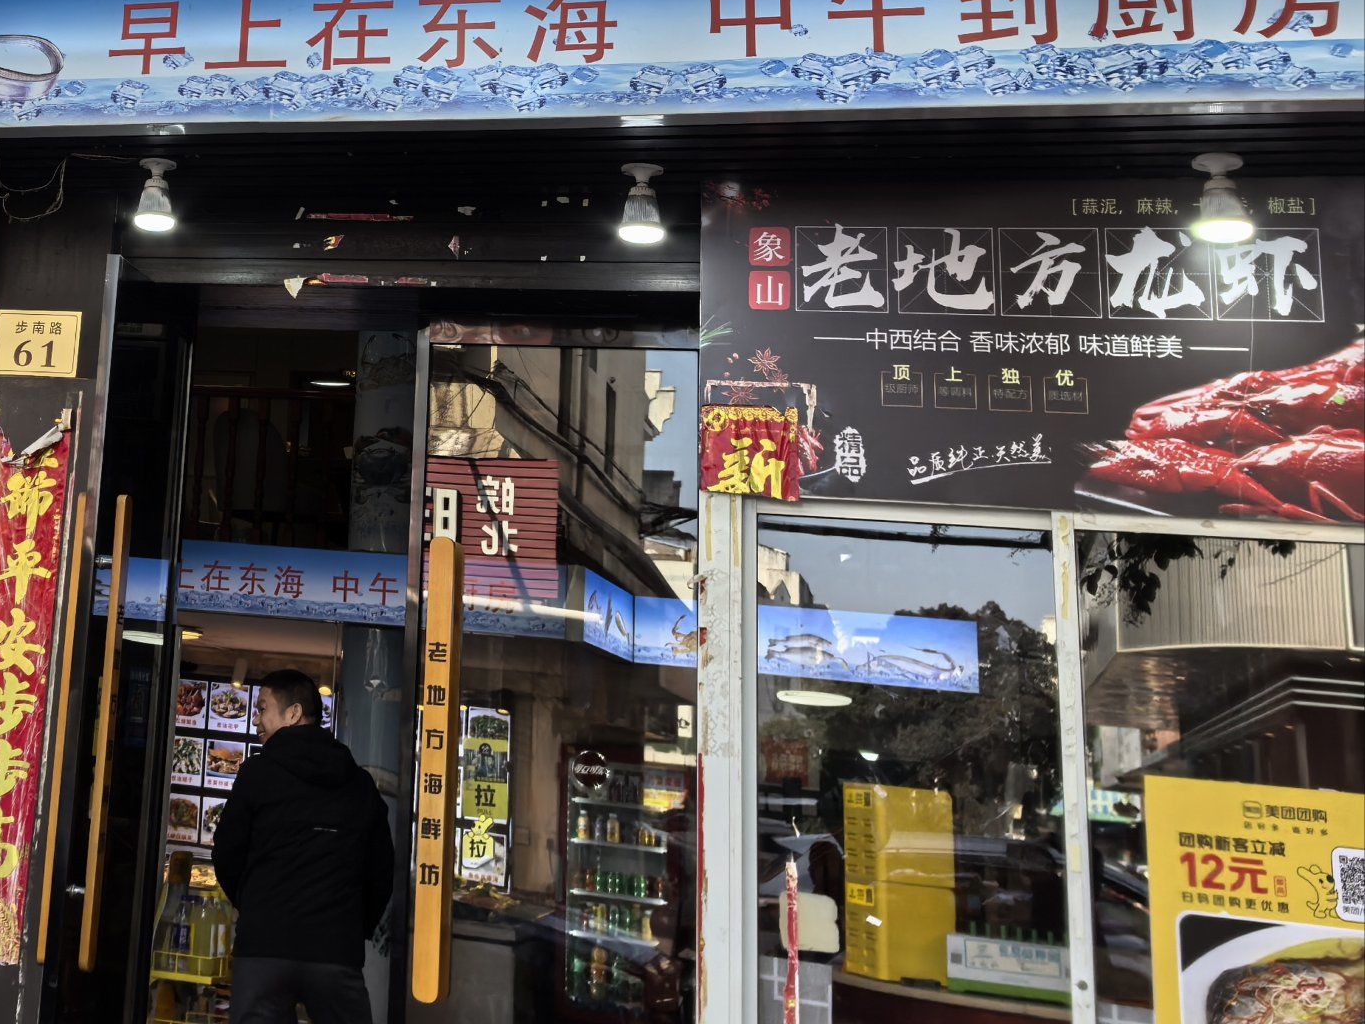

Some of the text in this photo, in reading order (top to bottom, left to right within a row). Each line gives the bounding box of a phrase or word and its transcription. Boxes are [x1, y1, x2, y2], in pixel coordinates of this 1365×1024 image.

[753, 229, 785, 309] 象山
[802, 223, 1319, 319] 老地方龙虾
[15, 321, 62, 336] 步南路
[865, 327, 1183, 360] 中西结合 香味浓郁 味道鲜美
[13, 340, 56, 368] 61
[332, 570, 399, 606] 中午
[419, 641, 448, 886] 老地方海鲜坊
[475, 784, 496, 808] 拉
[469, 839, 487, 858] 拉
[1179, 851, 1269, 895] 12元
